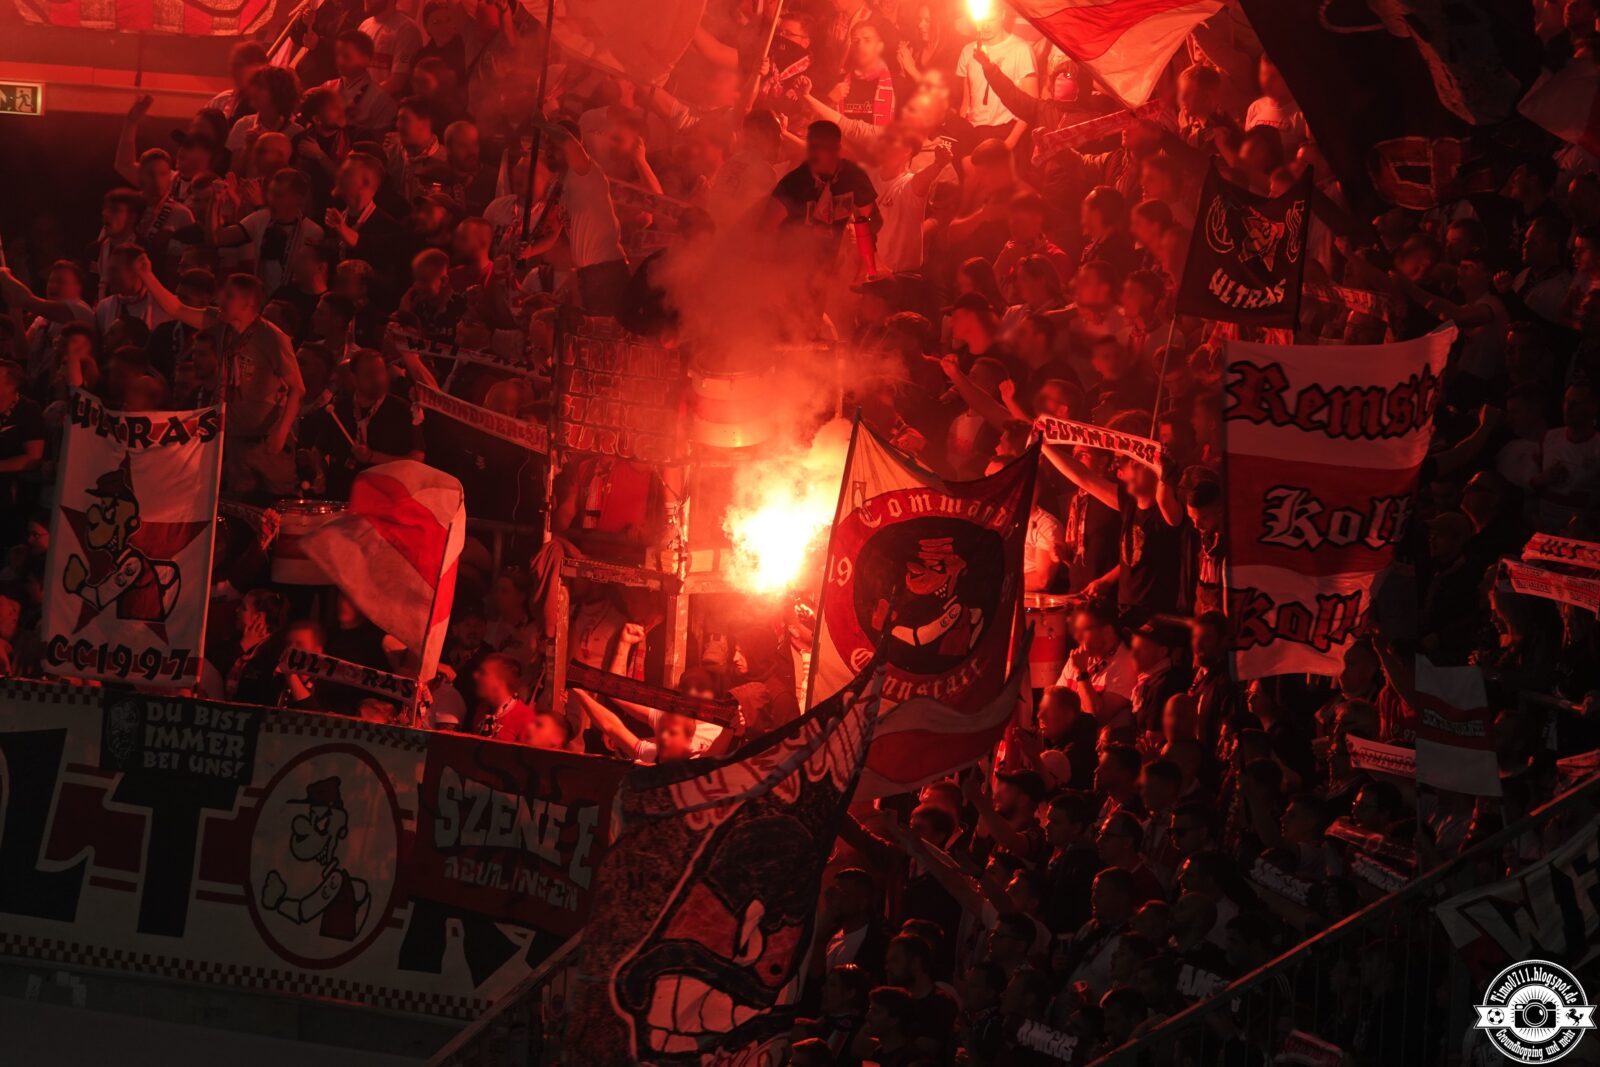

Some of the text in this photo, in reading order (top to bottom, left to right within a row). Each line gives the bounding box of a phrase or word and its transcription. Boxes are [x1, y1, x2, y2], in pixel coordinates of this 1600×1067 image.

[1208, 266, 1288, 310] ULTRAS
[71, 391, 218, 449] ULTRAS
[1045, 417, 1157, 465] COMMANDO
[827, 553, 854, 588] 19
[850, 647, 985, 702] Cnnstatt
[145, 701, 253, 732] DU BIST
[144, 723, 246, 759] IMMER
[143, 750, 246, 780] BEI UNS!
[434, 765, 569, 867] SZENE
